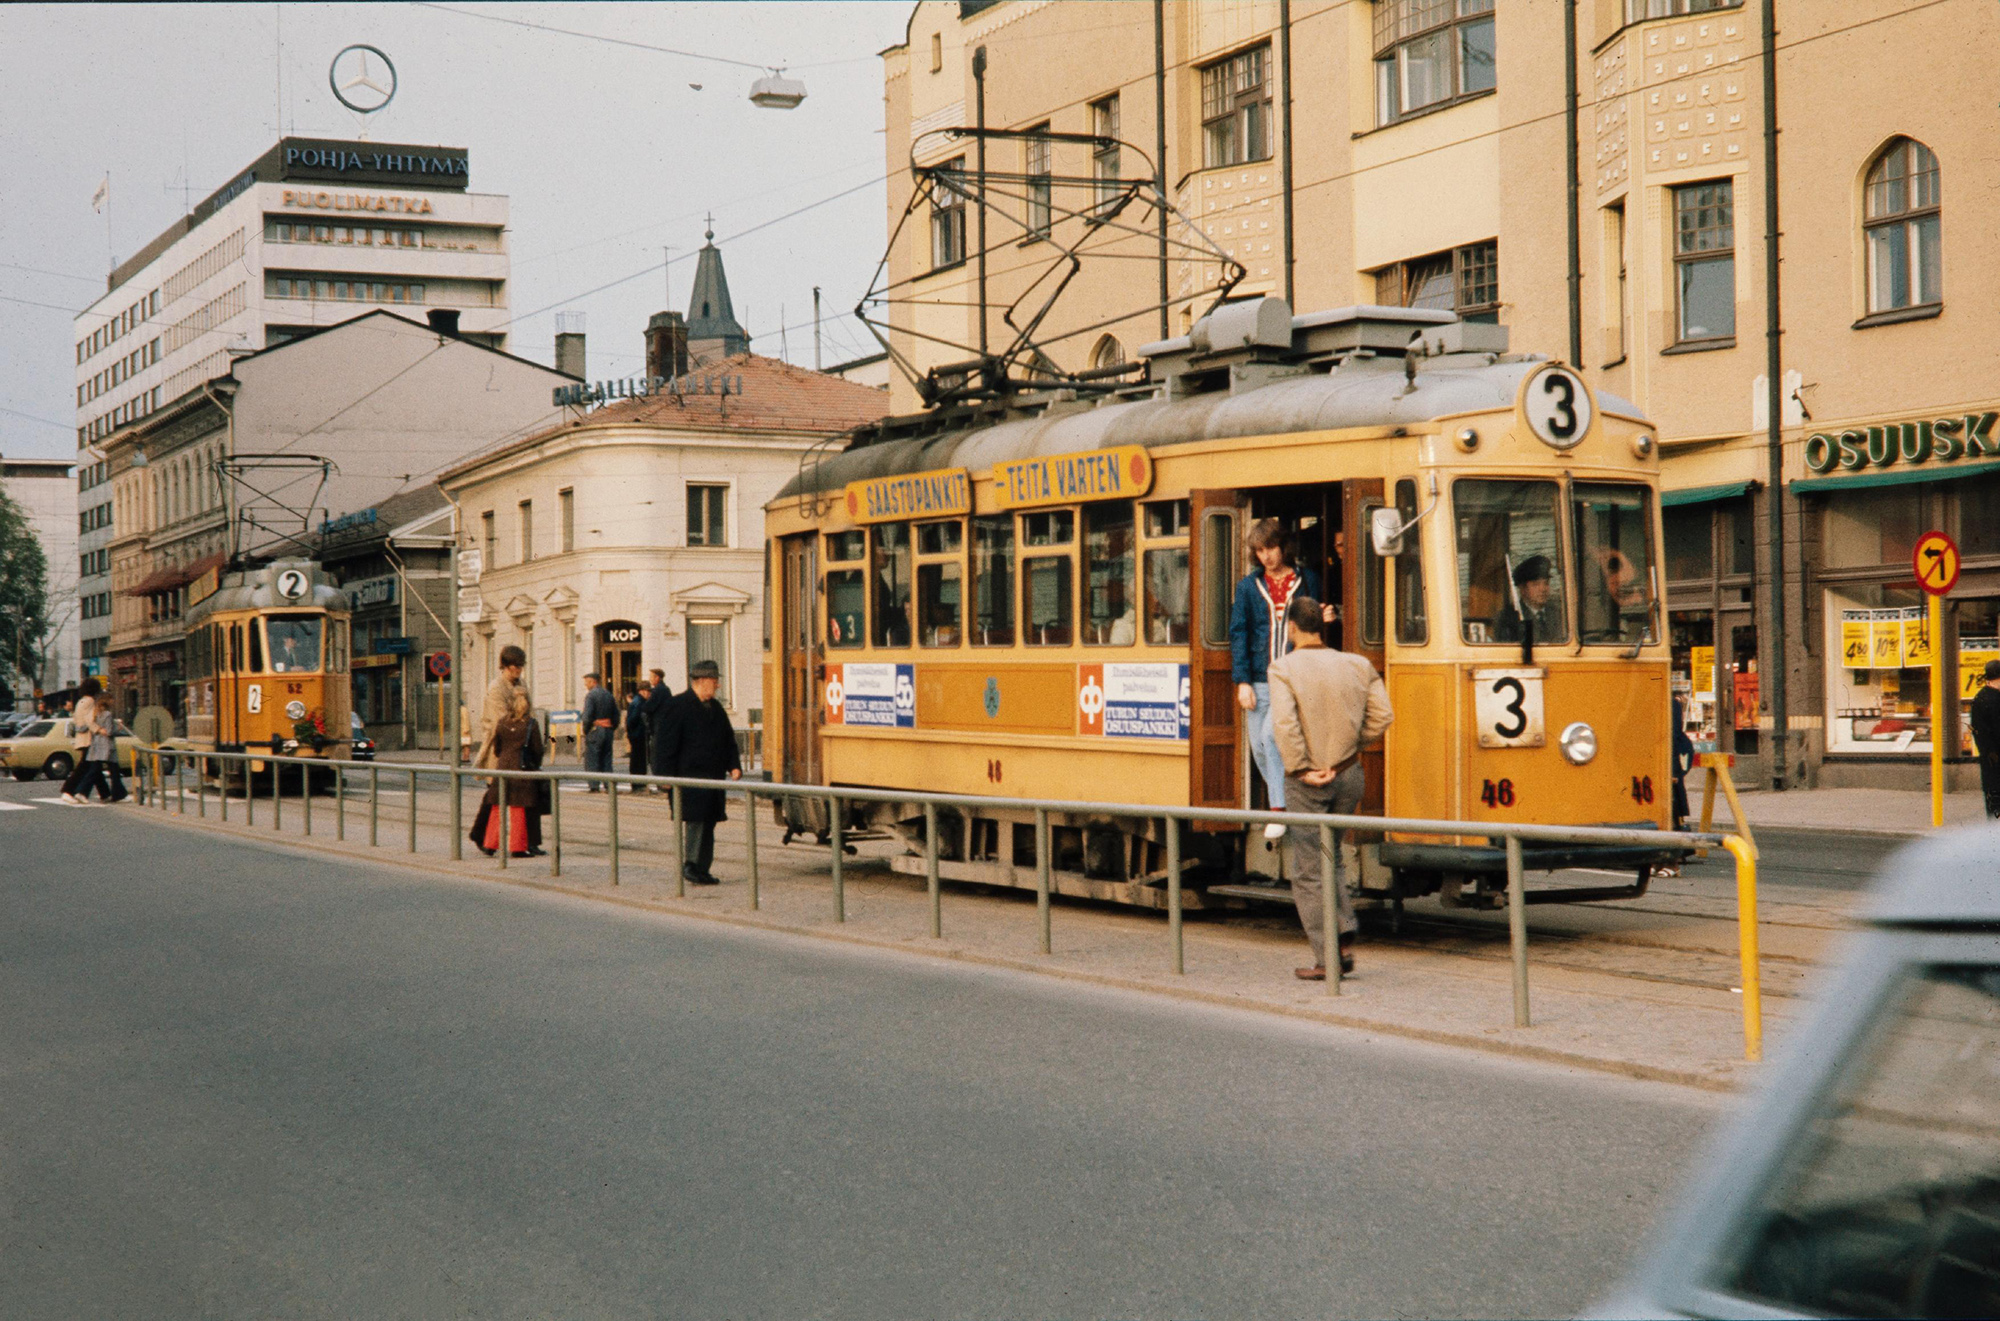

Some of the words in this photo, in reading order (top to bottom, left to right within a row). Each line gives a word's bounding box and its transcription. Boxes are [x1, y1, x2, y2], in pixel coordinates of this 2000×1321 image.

[286, 148, 469, 176] POHJA-YHTYMÄ
[282, 190, 434, 214] PUOLIMATKA
[1543, 373, 1577, 439] 3
[1805, 411, 2000, 474] OSUUSK
[1056, 452, 1120, 497] VARTEN
[285, 572, 300, 597] 2
[609, 629, 639, 642] KOP
[846, 614, 856, 640] 3
[250, 687, 259, 711] 2
[1493, 676, 1527, 739] 3
[1481, 778, 1516, 809] 46
[1632, 774, 1654, 805] 46
